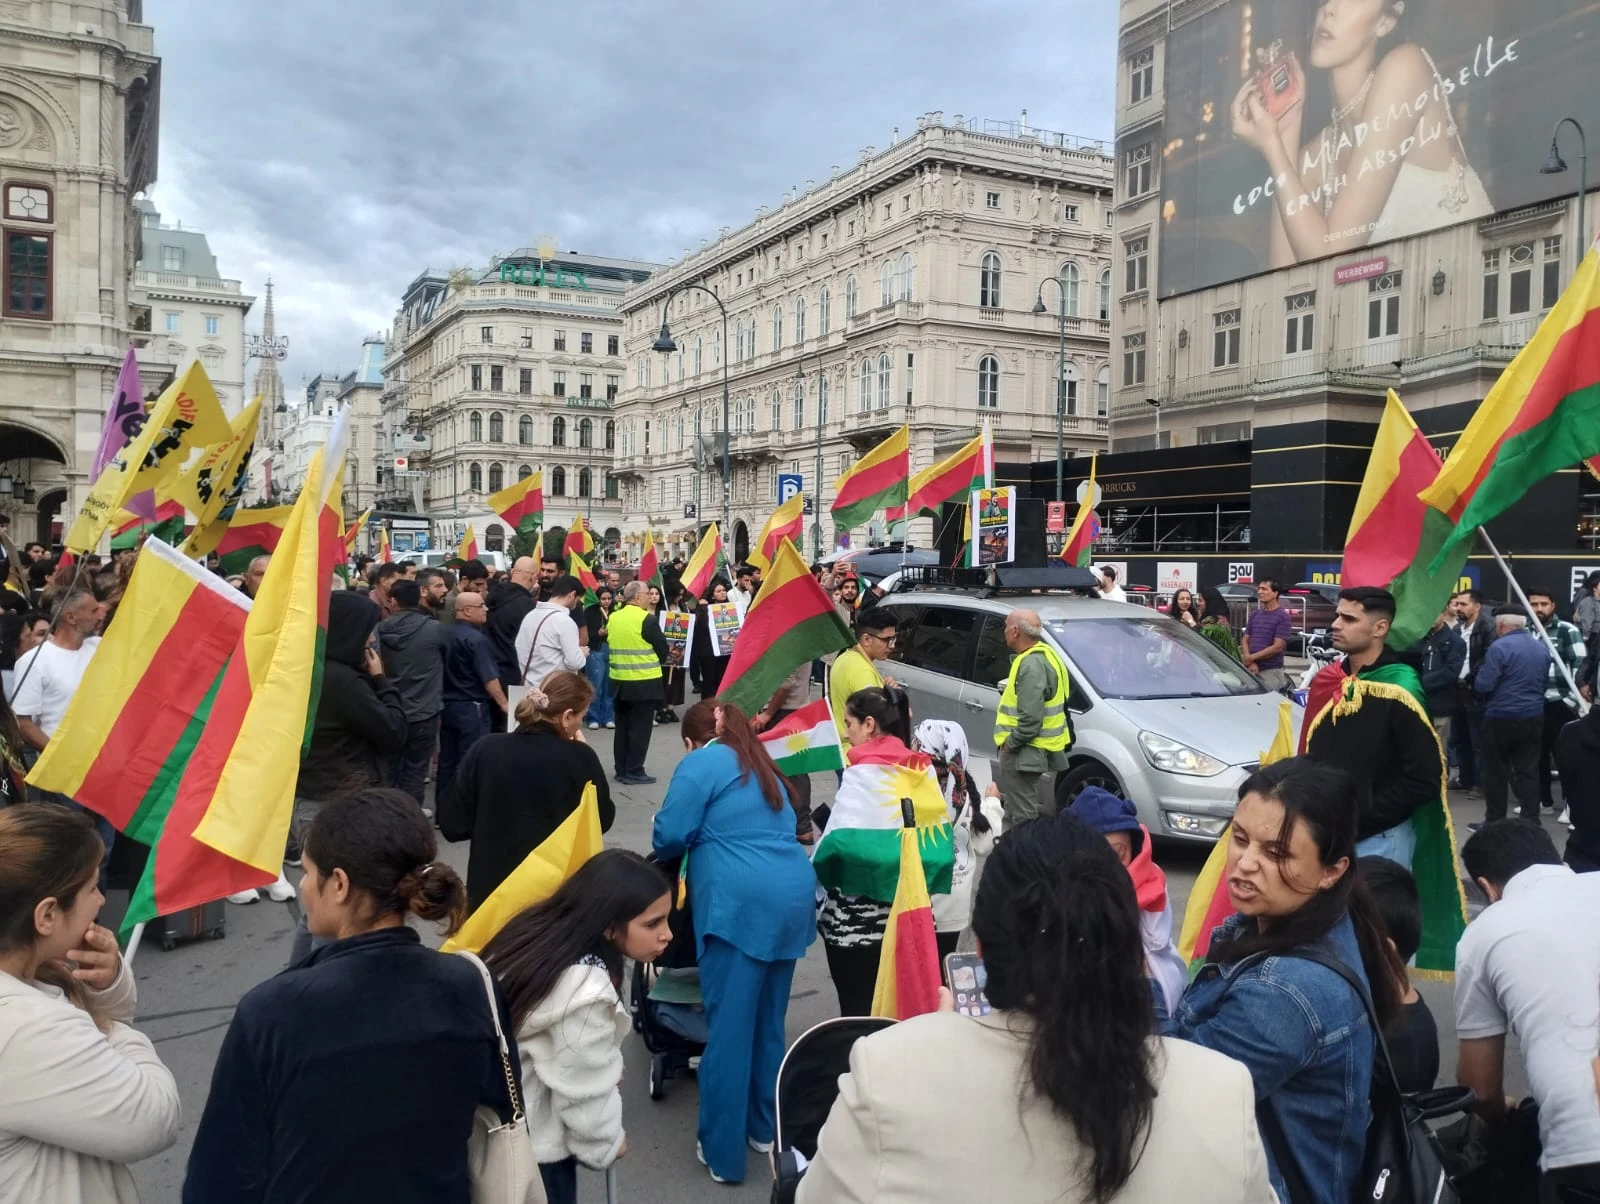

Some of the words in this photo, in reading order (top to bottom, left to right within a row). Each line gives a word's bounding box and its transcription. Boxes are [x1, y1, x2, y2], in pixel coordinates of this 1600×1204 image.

[1286, 173, 1348, 216] CRUSH
[1357, 116, 1442, 181] ABSOLU
[1232, 172, 1288, 215] COCO
[500, 263, 590, 291] ROLEX
[1337, 261, 1385, 280] WERBEWAND
[1101, 482, 1136, 493] ARBUCKS
